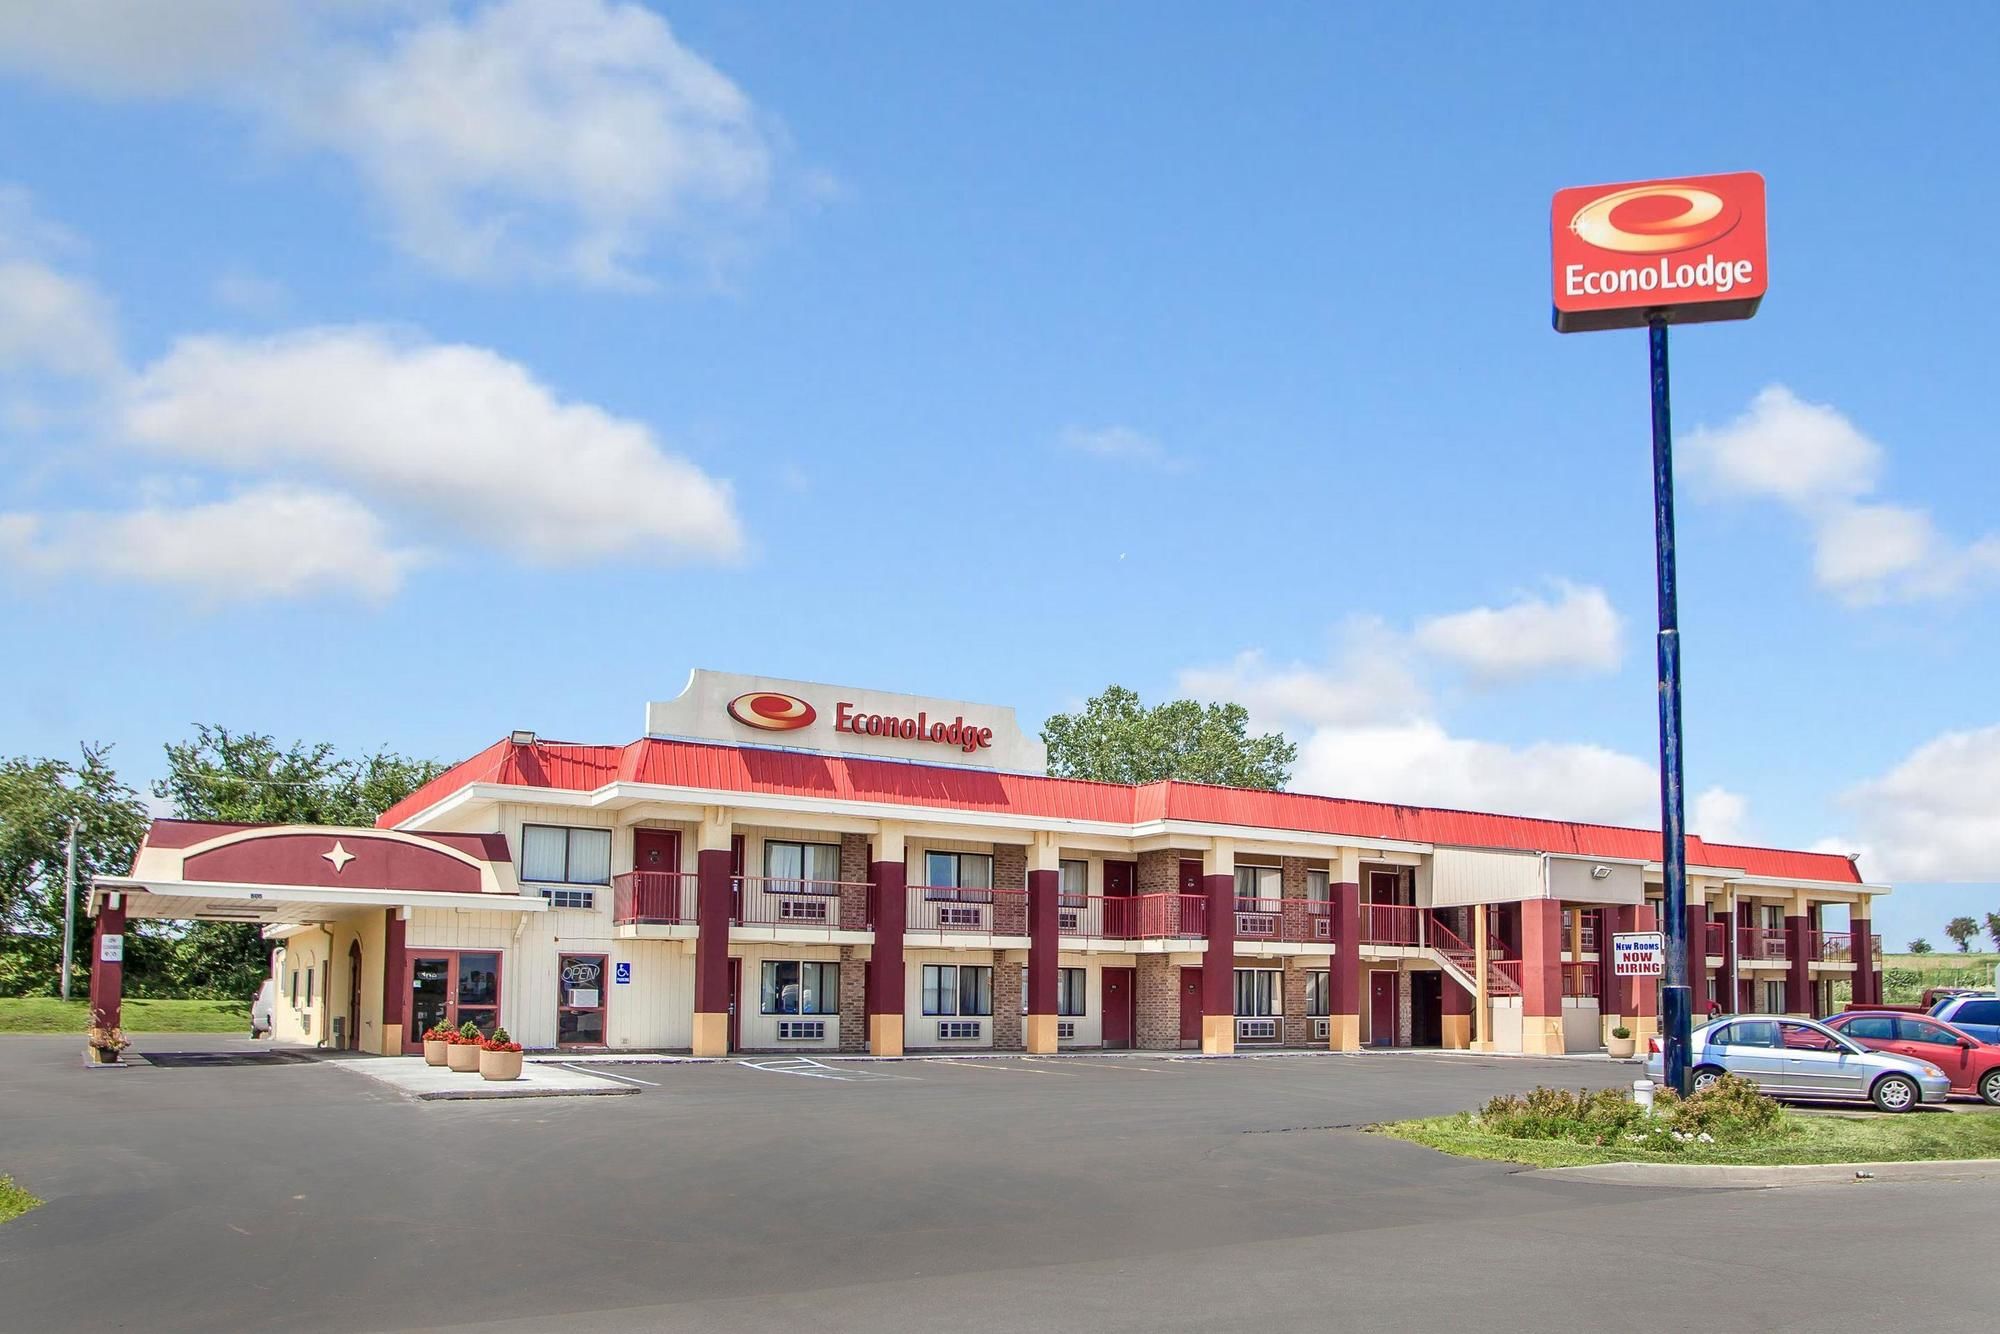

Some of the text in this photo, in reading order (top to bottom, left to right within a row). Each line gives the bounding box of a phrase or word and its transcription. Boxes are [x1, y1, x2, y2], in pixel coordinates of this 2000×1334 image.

[1566, 254, 1752, 296] EconoLodge
[835, 702, 993, 753] EconoLodge
[1623, 952, 1653, 962] NOW
[562, 966, 597, 980] OPEN
[1616, 963, 1660, 973] HIRING
